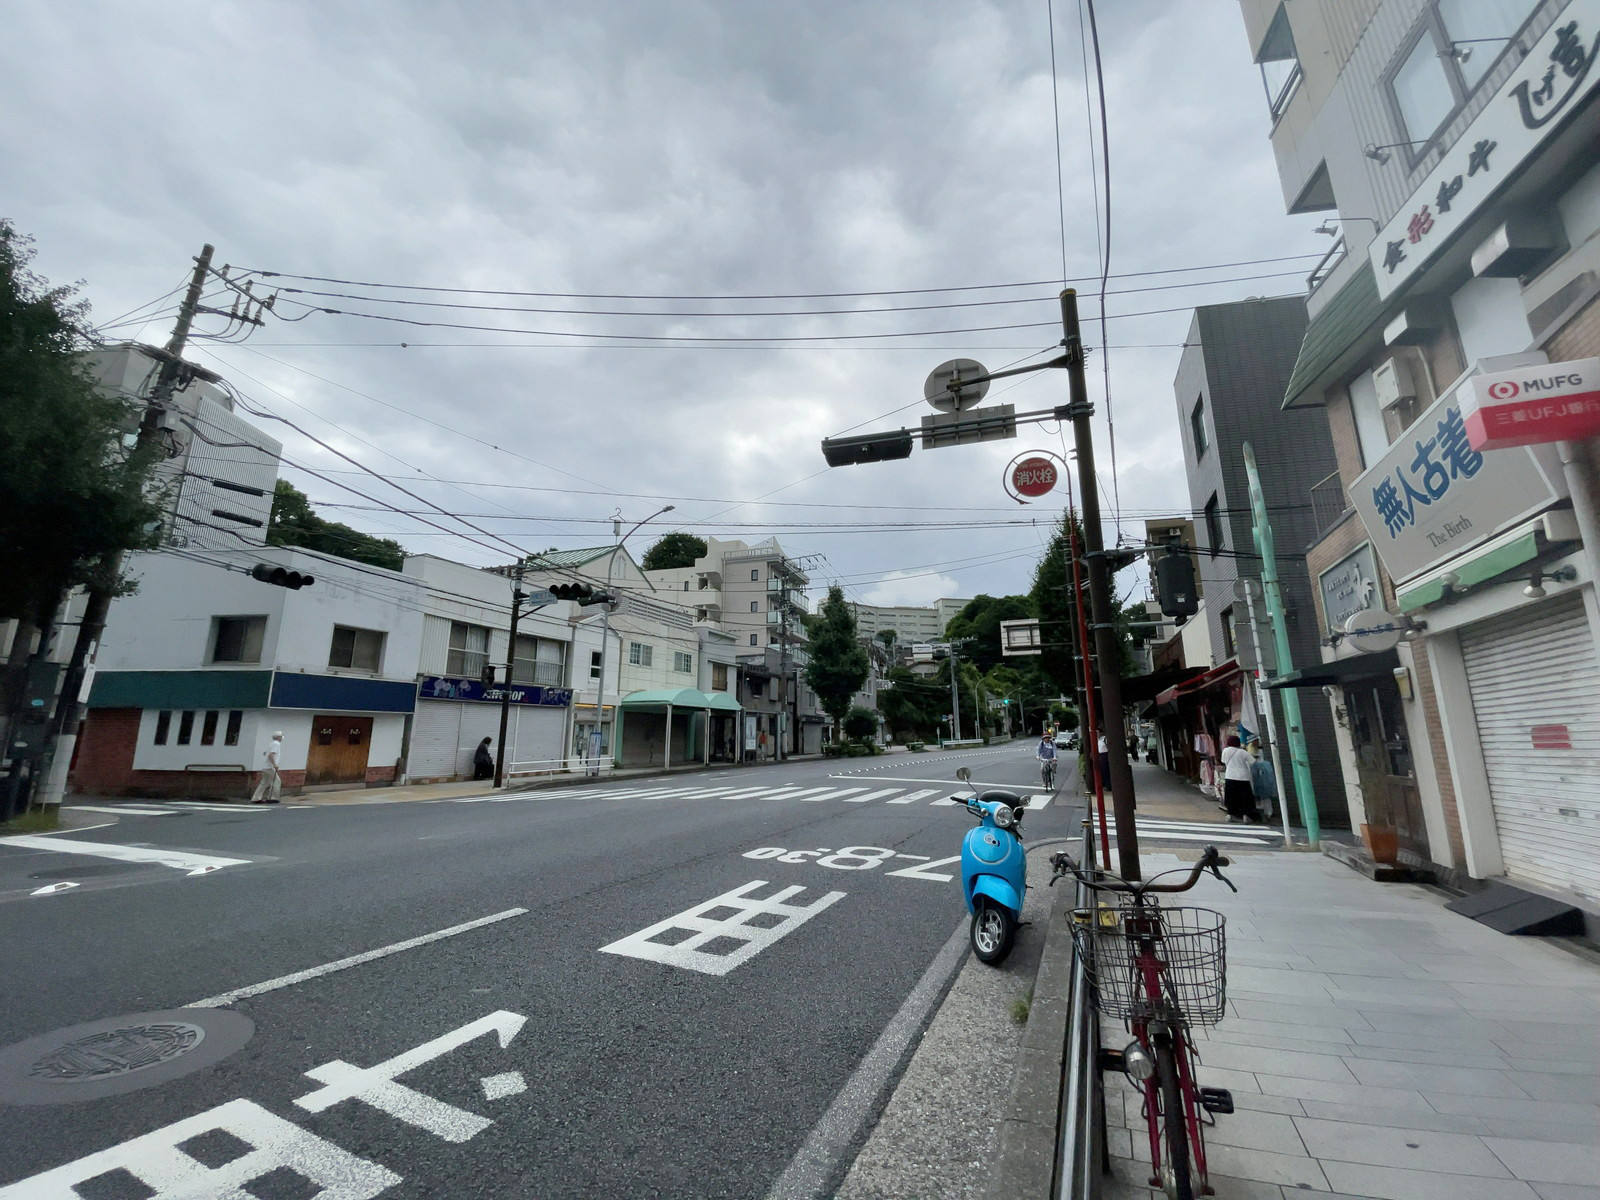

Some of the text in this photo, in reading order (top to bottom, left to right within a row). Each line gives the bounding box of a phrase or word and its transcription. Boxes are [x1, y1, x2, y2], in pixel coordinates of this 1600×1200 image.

[1523, 373, 1583, 393] MUFG
[1495, 399, 1600, 425] 三菱UFJ銀行
[1017, 468, 1053, 487] 消火栓
[1372, 406, 1484, 539] 無人古着
[1426, 514, 1473, 549] The Birth
